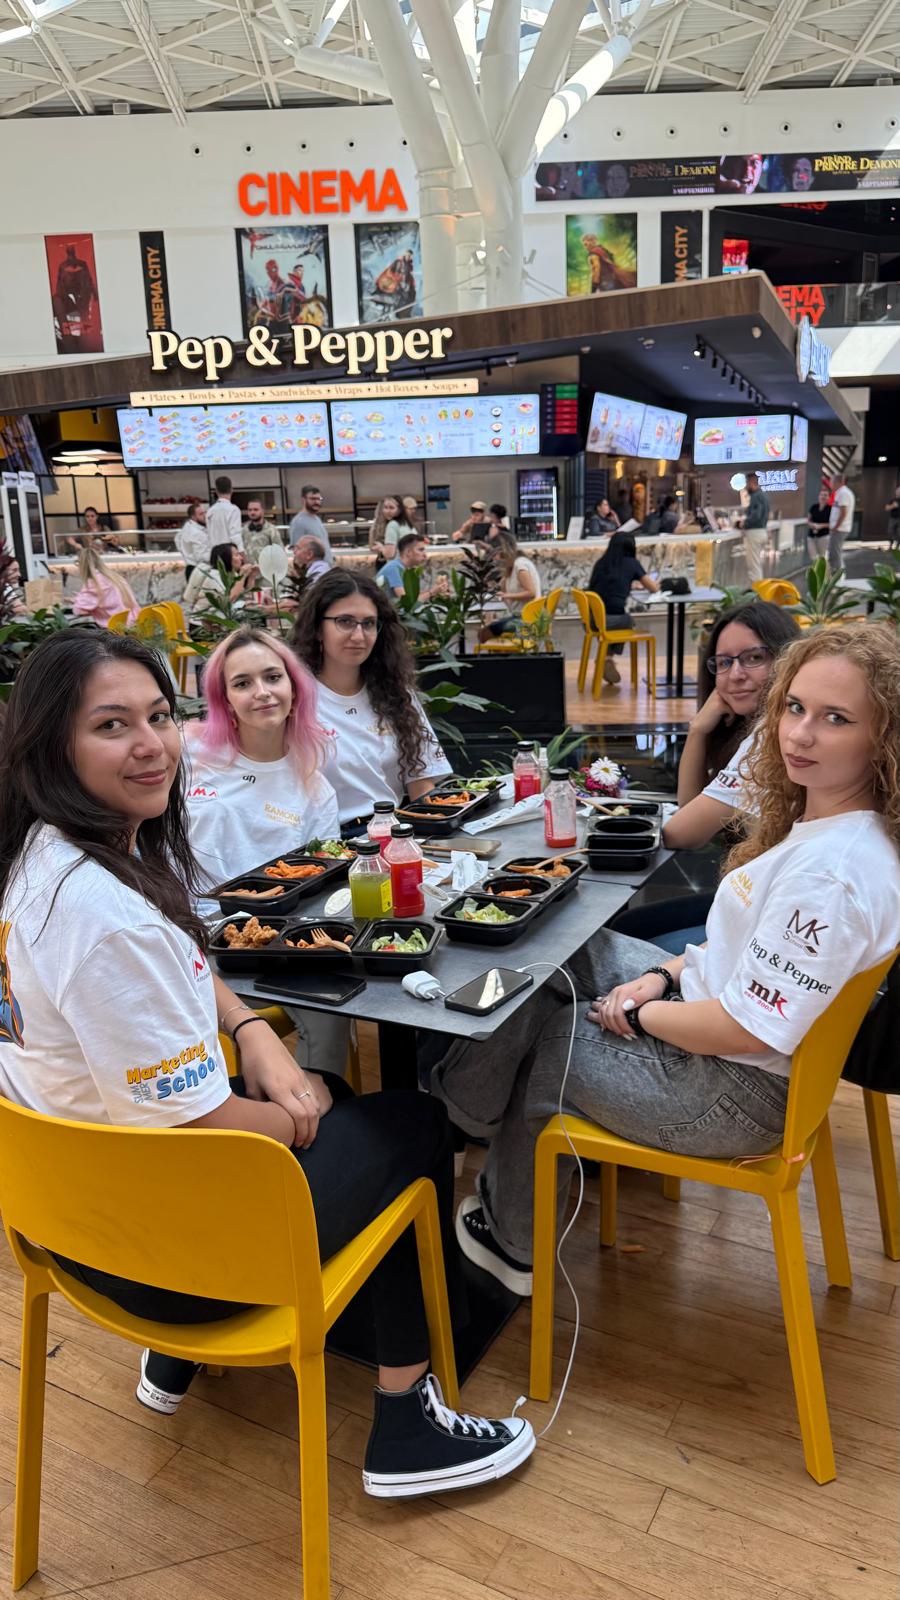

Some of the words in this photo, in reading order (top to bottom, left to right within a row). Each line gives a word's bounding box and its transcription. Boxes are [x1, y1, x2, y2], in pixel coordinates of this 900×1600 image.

[238, 168, 407, 216] CINEMA
[147, 246, 162, 279] CITY
[674, 225, 689, 259] CITY
[150, 281, 166, 330] INEMA
[776, 284, 826, 307] EMA
[789, 306, 826, 327] ITY
[147, 329, 234, 380] Pep
[246, 325, 282, 366] &
[291, 323, 453, 375] Pepper
[149, 392, 177, 402] Plates
[189, 391, 216, 401] Bowls
[228, 390, 257, 400] Pastas
[269, 386, 322, 398] Sandwiches
[335, 385, 363, 397] Wraps
[375, 383, 392, 393] Hot
[394, 382, 420, 393] Boxes
[432, 381, 459, 392] Soups
[786, 909, 830, 946] MK
[748, 937, 768, 961] Pep
[768, 953, 782, 968] &
[783, 960, 833, 995] Pepper
[746, 979, 790, 1021] mk
[126, 1039, 208, 1085] Marketing
[156, 1056, 218, 1099] Schoo
